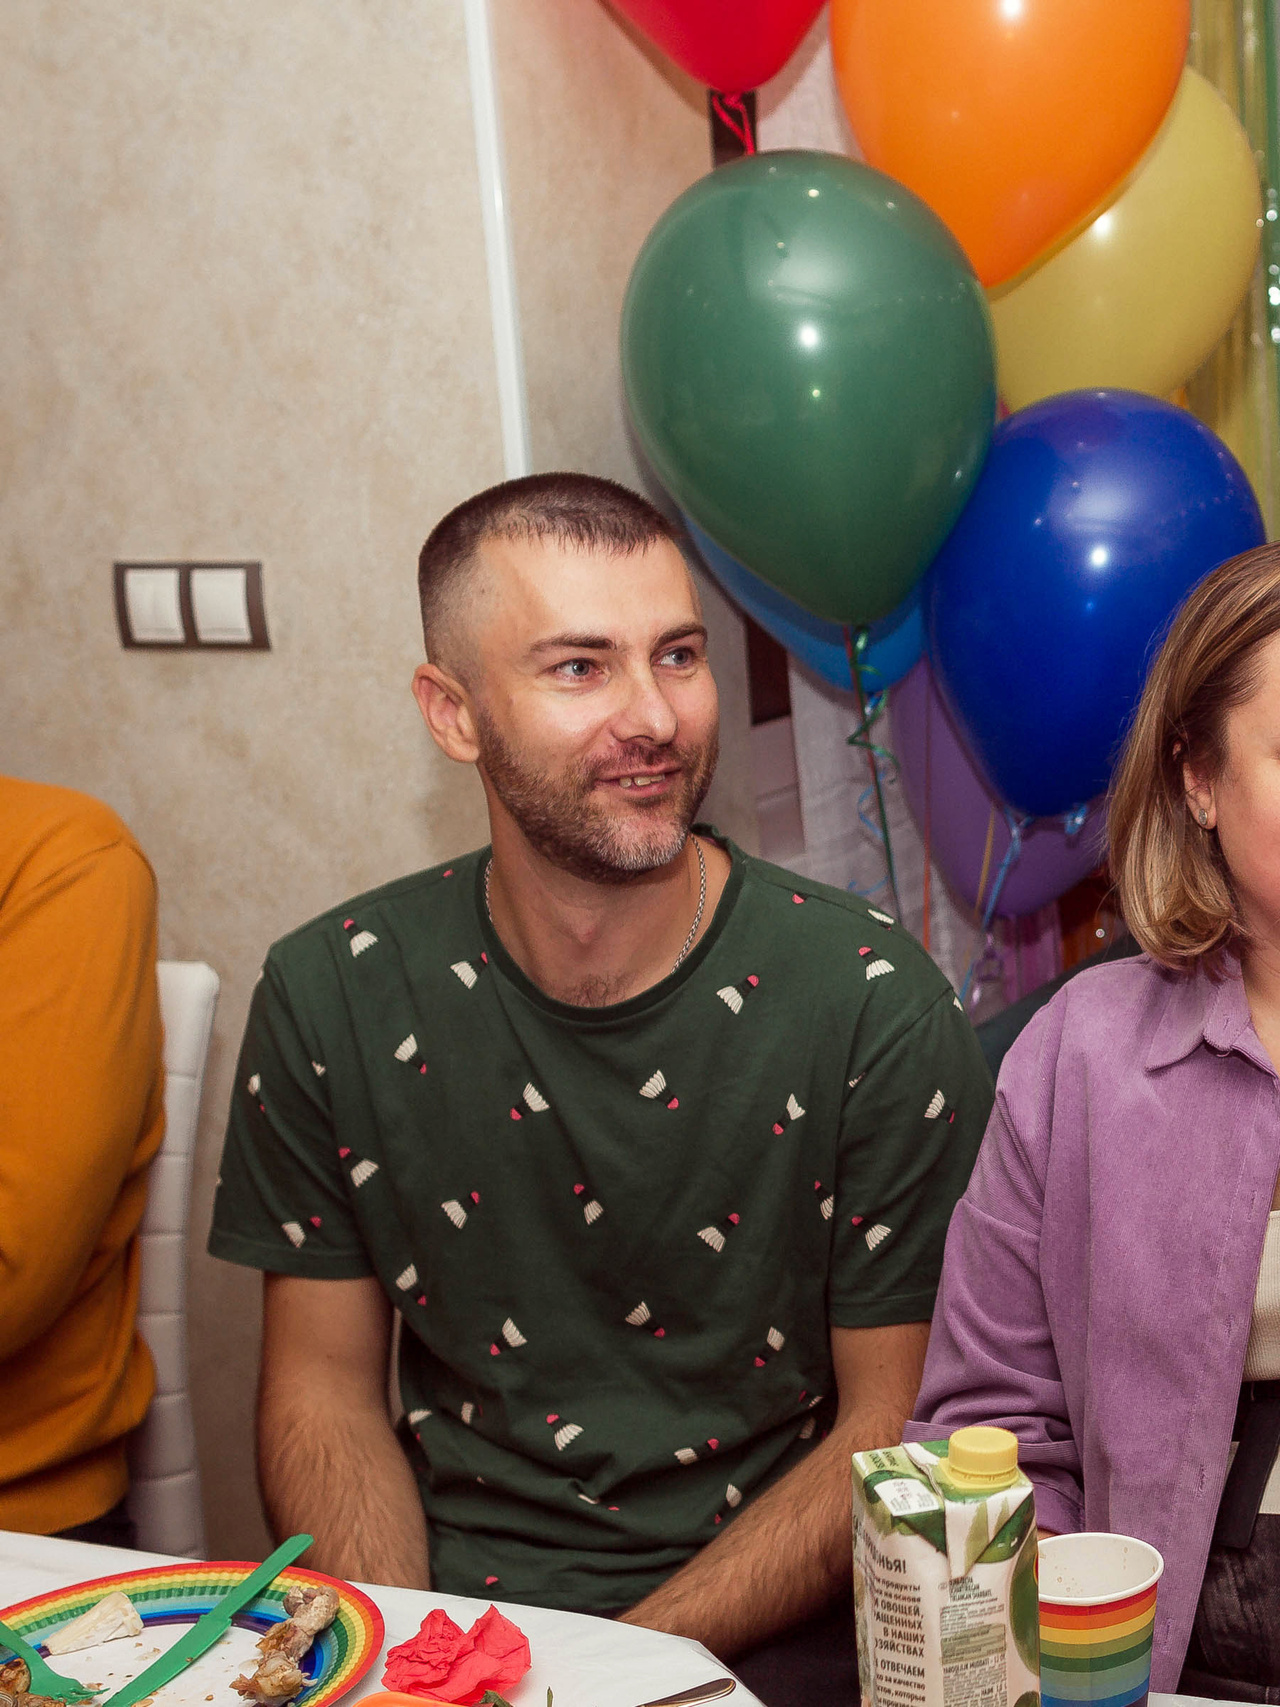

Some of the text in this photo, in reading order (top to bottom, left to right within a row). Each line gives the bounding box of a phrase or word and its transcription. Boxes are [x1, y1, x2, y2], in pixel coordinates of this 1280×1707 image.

[882, 1579, 921, 1592] продукты
[880, 1599, 924, 1619] ОВОЩЕЙ,
[883, 1627, 925, 1645] В НАШИХ
[880, 1658, 925, 1679] ОТВЕЧАЕМ
[893, 1678, 926, 1691] качество
[894, 1690, 926, 1703] которые
